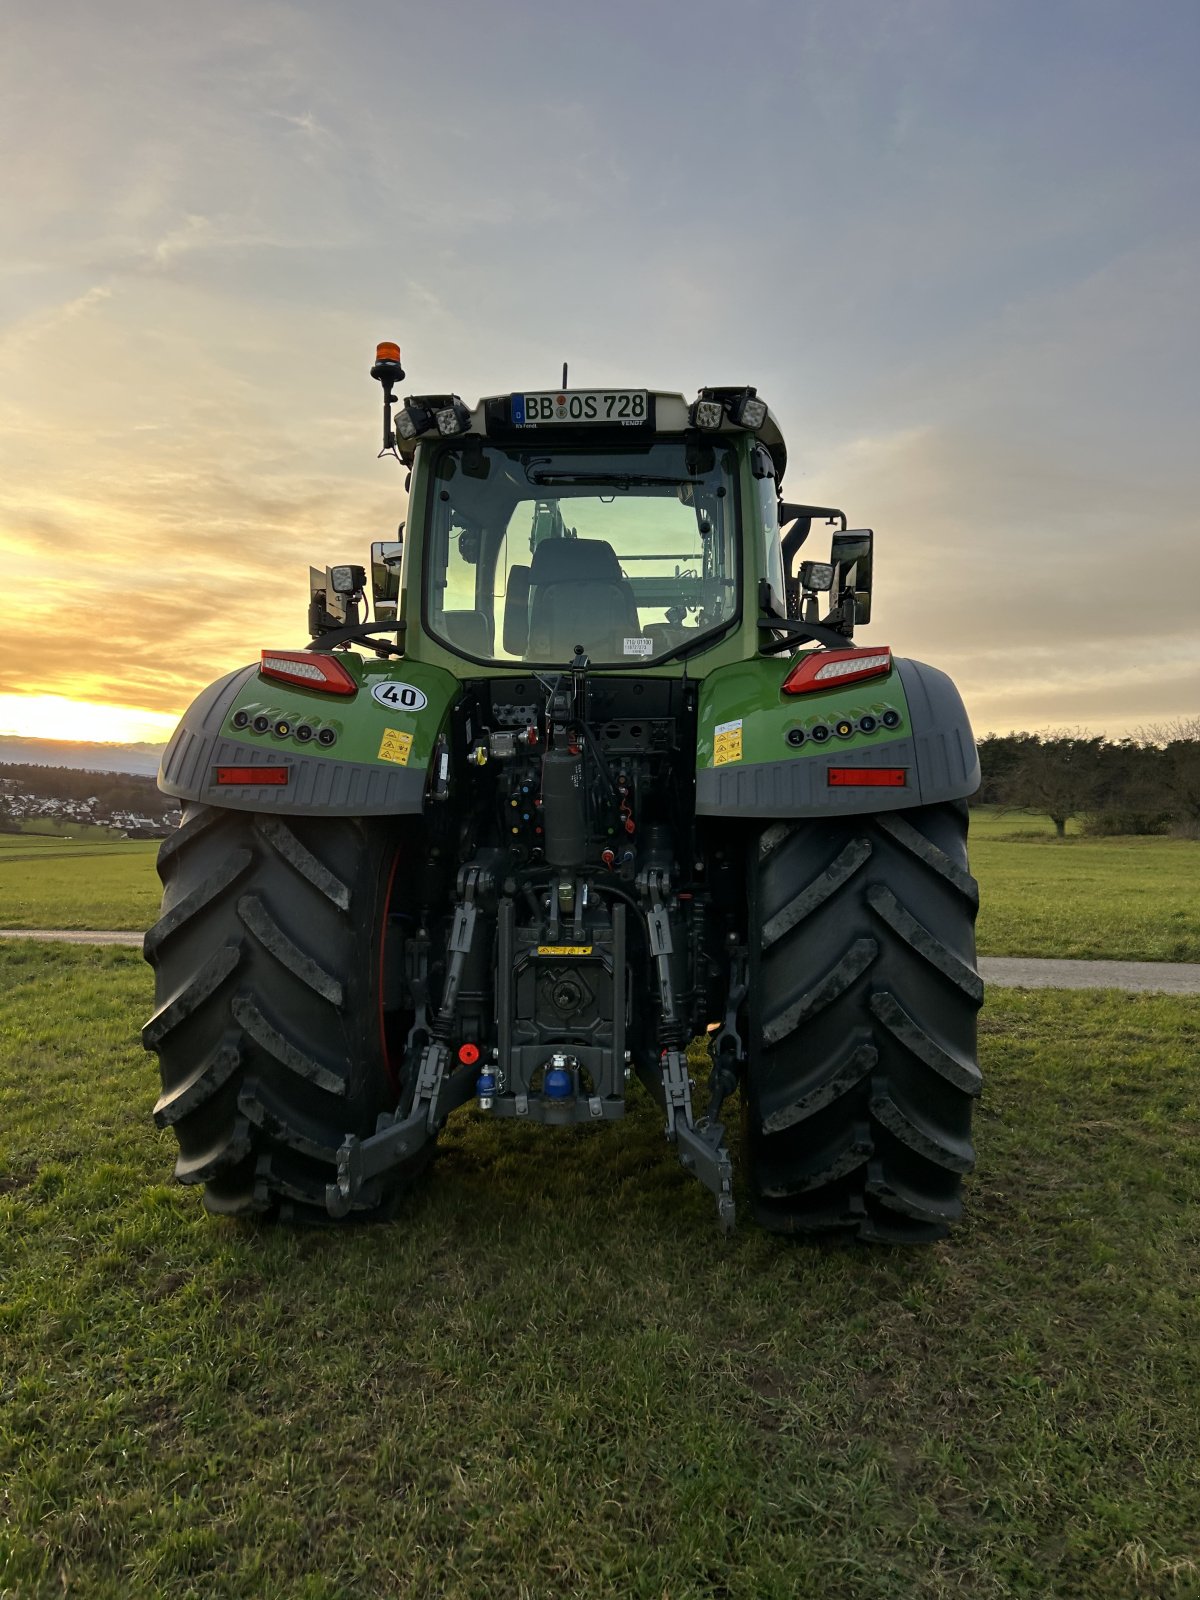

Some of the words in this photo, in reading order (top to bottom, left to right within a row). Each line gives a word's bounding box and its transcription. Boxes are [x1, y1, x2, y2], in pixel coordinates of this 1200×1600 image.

[526, 398, 554, 419] BB
[569, 396, 597, 419] OS
[603, 395, 644, 418] 728
[382, 686, 416, 706] 40
